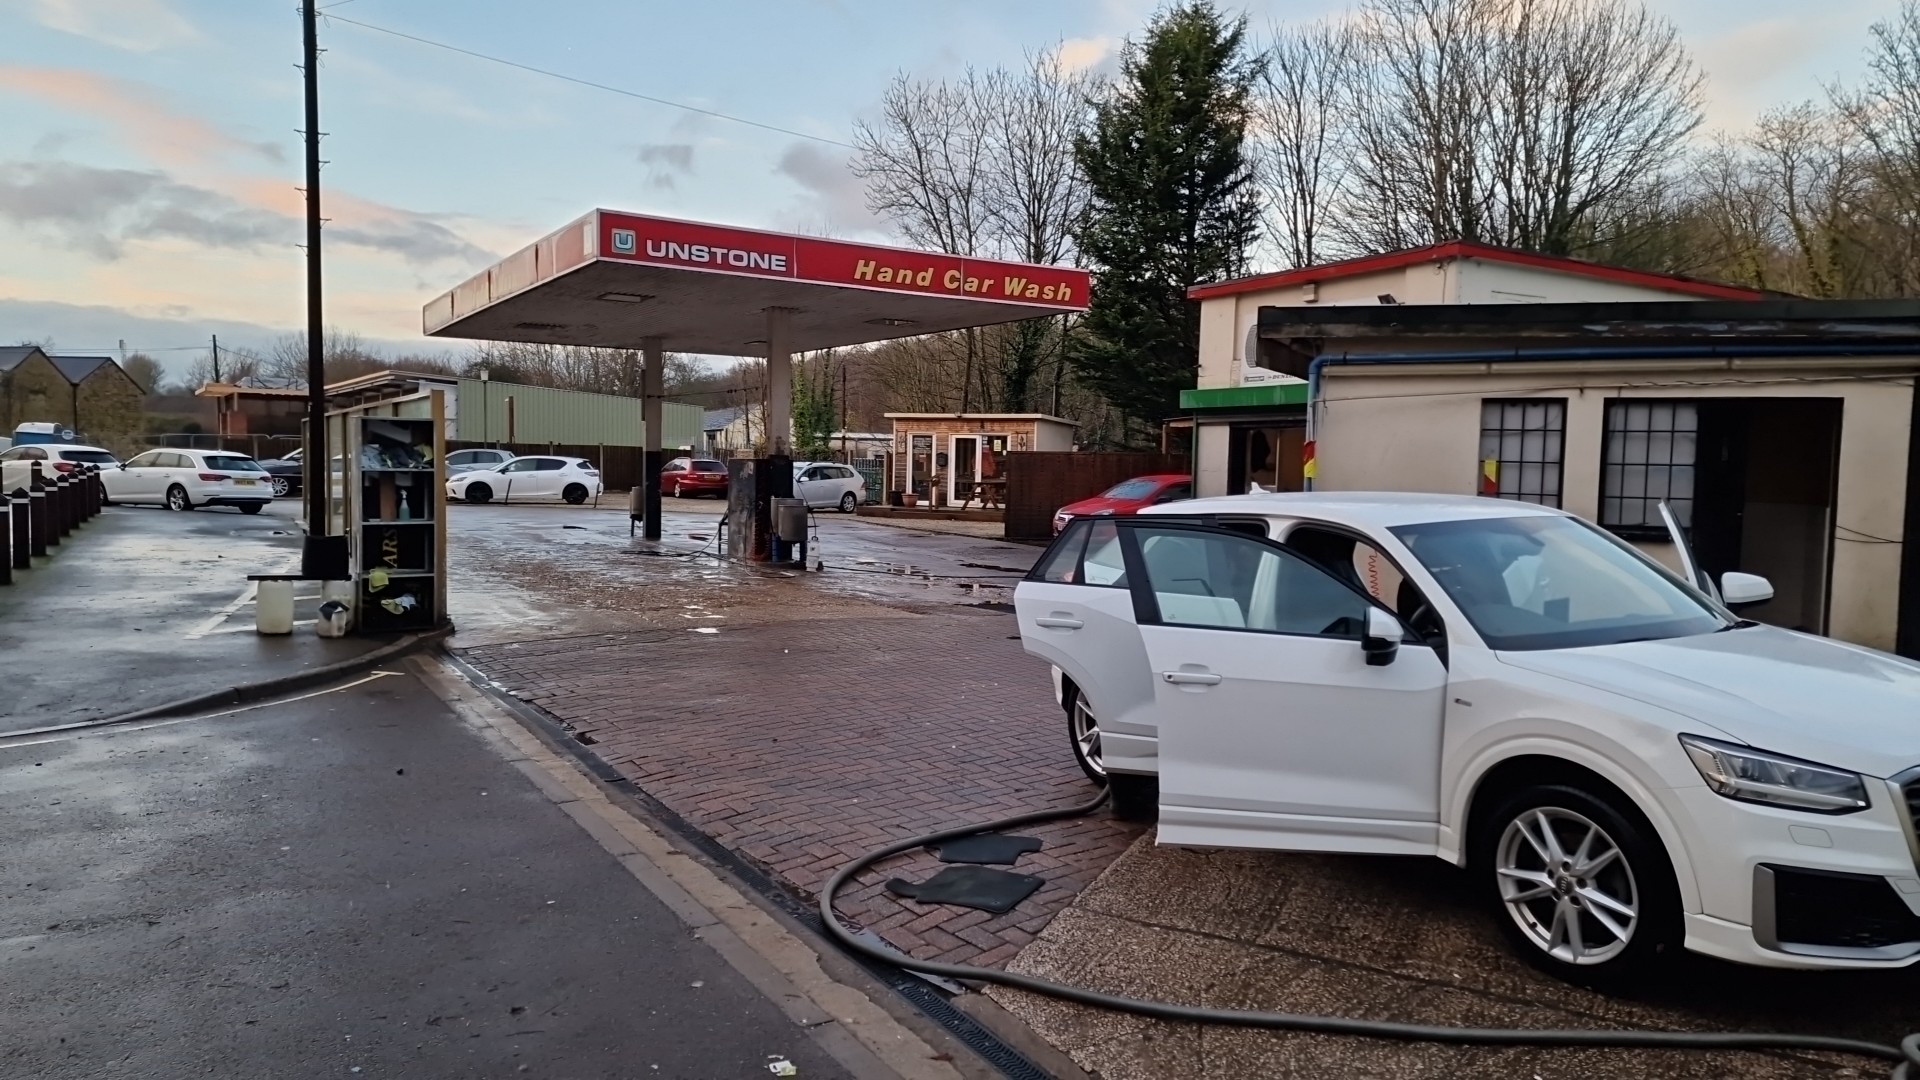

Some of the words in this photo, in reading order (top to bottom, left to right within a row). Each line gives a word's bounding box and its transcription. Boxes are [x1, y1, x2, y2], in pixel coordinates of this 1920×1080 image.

[614, 232, 634, 250] U
[646, 239, 787, 272] UNSTONE
[854, 259, 934, 287] Hand
[943, 269, 994, 293] Car
[1004, 276, 1072, 301] Wash
